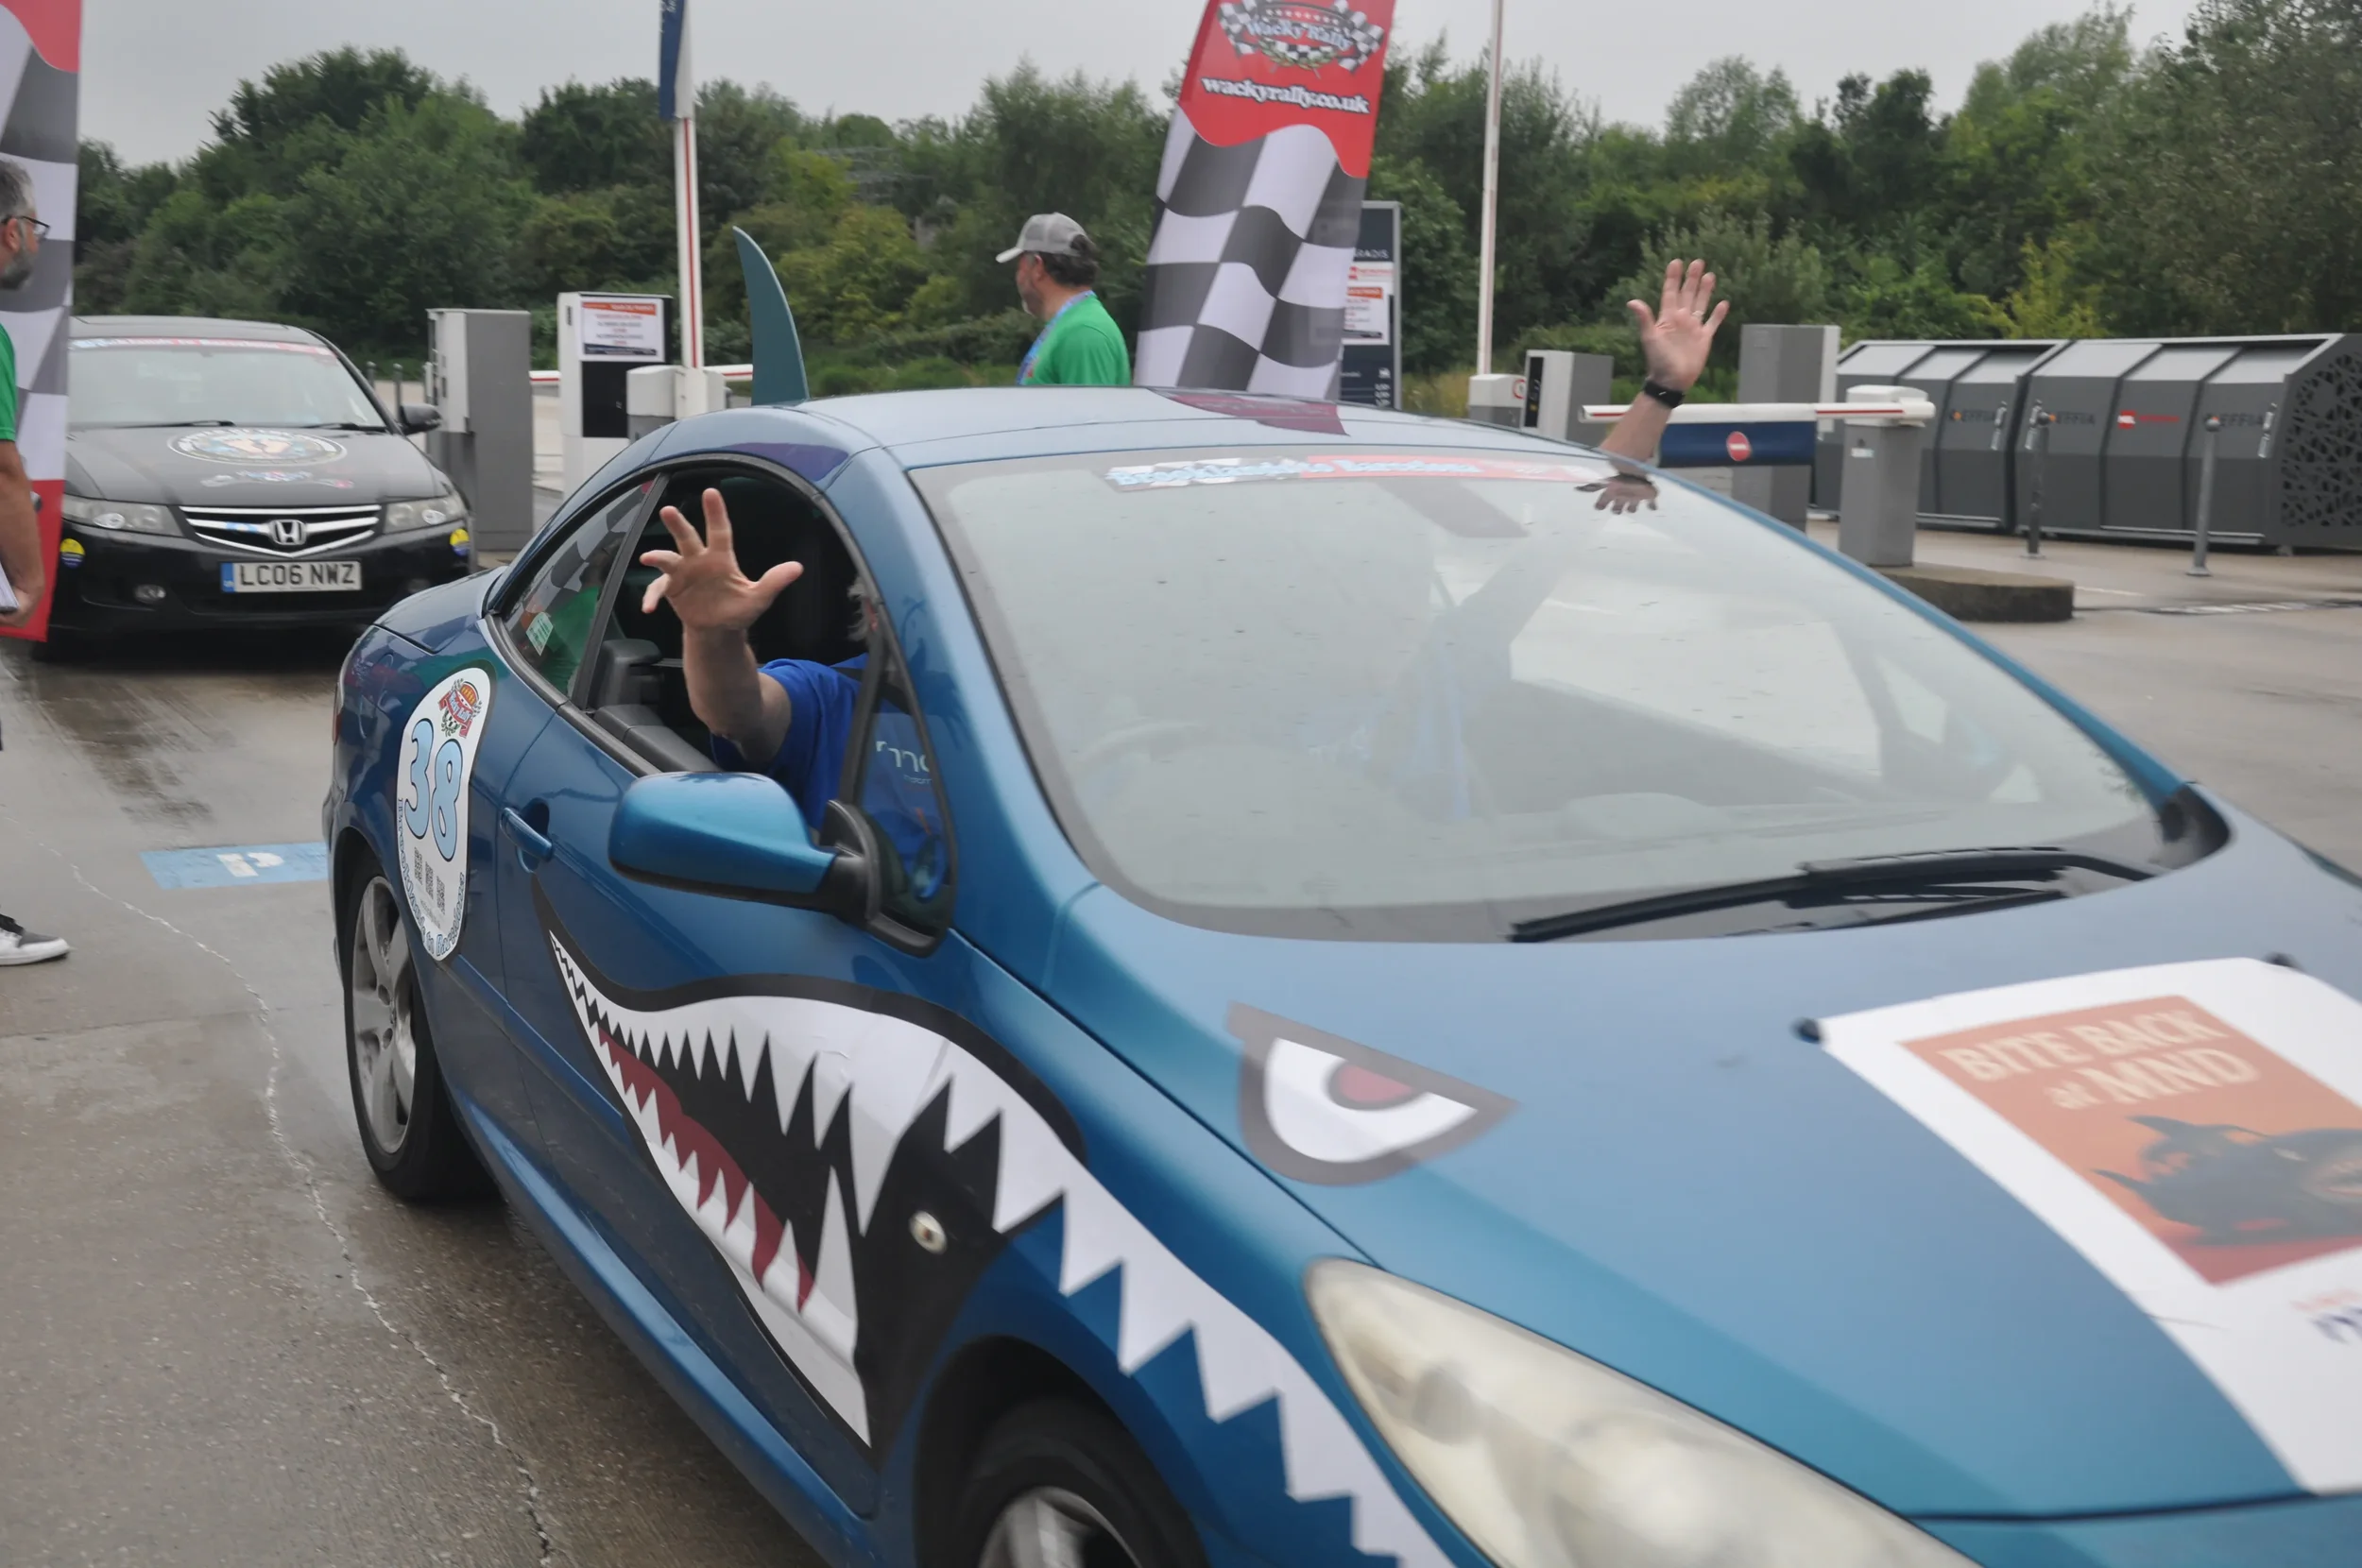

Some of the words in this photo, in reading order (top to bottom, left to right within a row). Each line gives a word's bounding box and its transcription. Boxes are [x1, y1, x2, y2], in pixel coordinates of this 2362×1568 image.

[1201, 77, 1370, 113] wackyrally.co.uk
[239, 563, 303, 586] LC06
[309, 563, 355, 585] NWZ
[404, 717, 464, 862] 38
[1937, 1031, 2093, 1082] BITE
[2063, 1010, 2230, 1064] BACK
